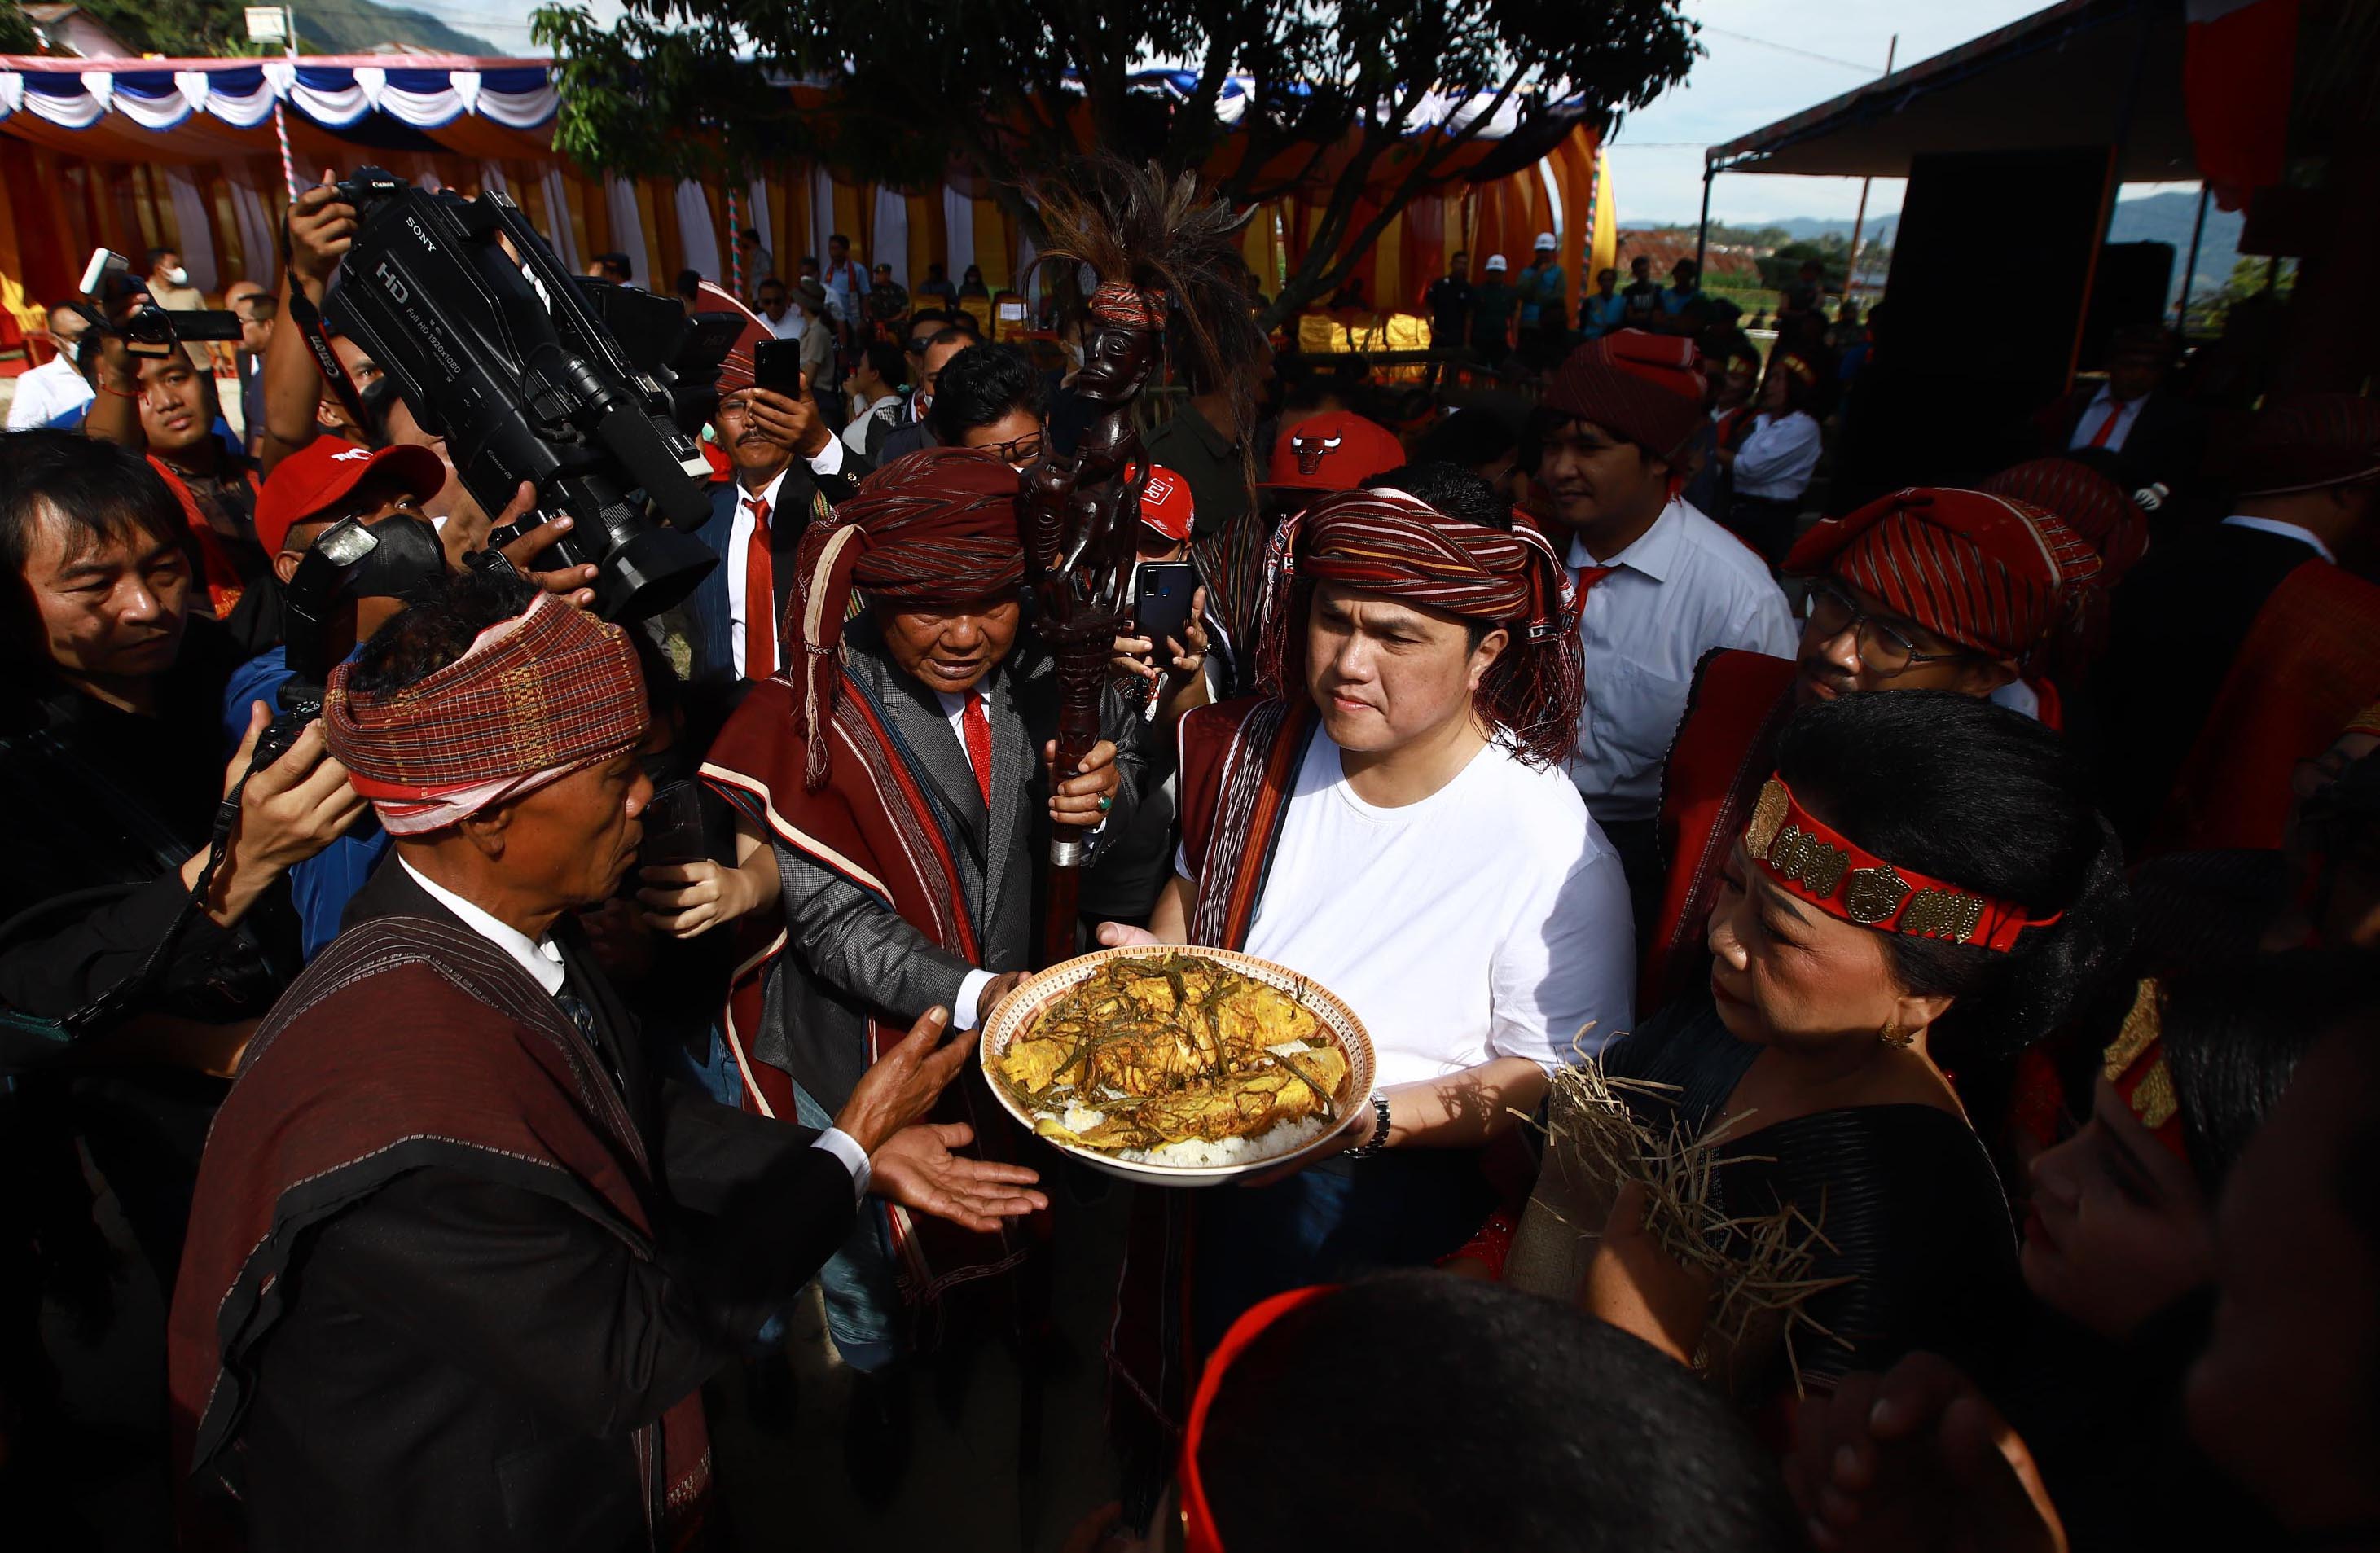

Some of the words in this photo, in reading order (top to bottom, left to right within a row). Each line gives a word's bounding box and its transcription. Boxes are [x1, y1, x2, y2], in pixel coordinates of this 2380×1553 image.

[371, 179, 396, 188] Canon
[406, 217, 437, 252] SONY
[375, 261, 409, 304] HD
[310, 335, 339, 378] Canon
[406, 307, 420, 322] Full
[417, 321, 429, 334] HD
[428, 333, 461, 373] 1920x1080
